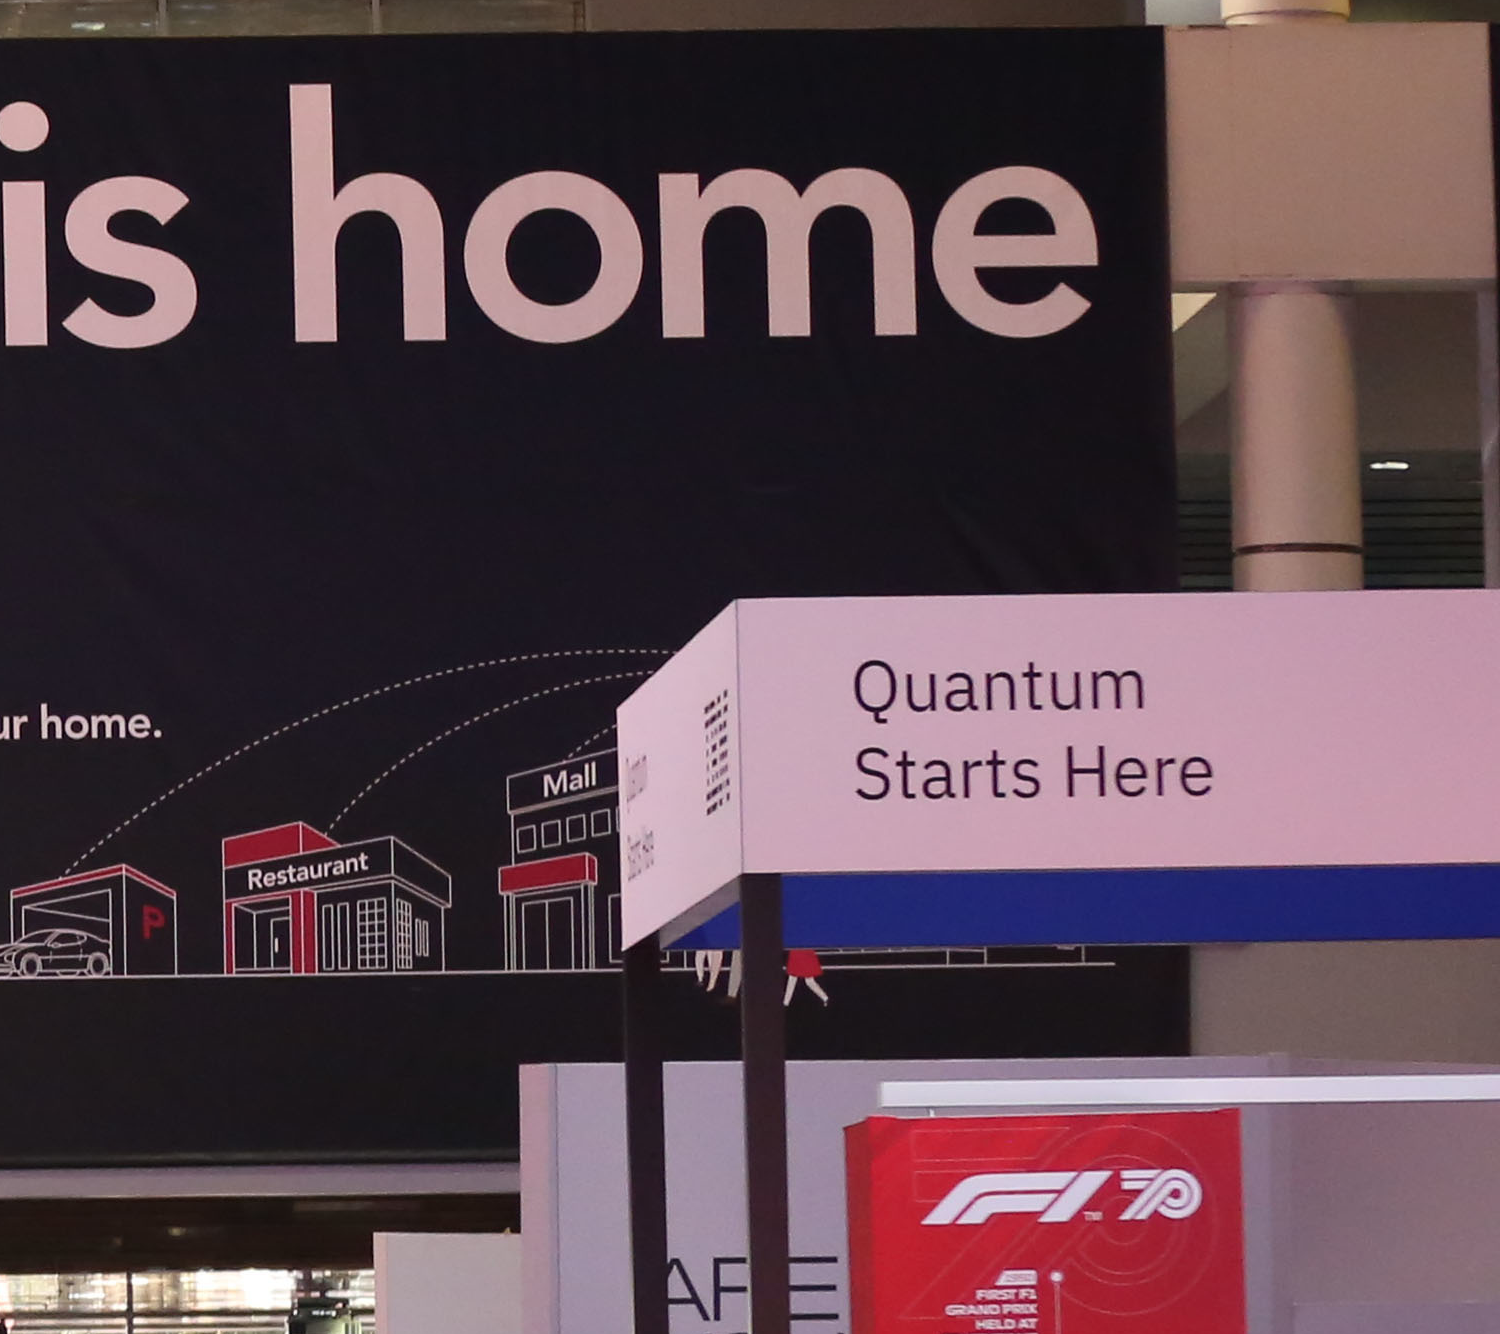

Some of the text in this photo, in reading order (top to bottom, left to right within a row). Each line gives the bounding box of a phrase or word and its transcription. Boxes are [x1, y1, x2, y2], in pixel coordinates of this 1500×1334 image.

[289, 83, 1099, 344] home
[854, 659, 1145, 725] Quantum
[40, 702, 162, 740] home.
[542, 763, 598, 799] Mall
[855, 745, 1214, 800] Starts Here
[247, 851, 369, 891] Restaurant
[142, 905, 165, 939] P
